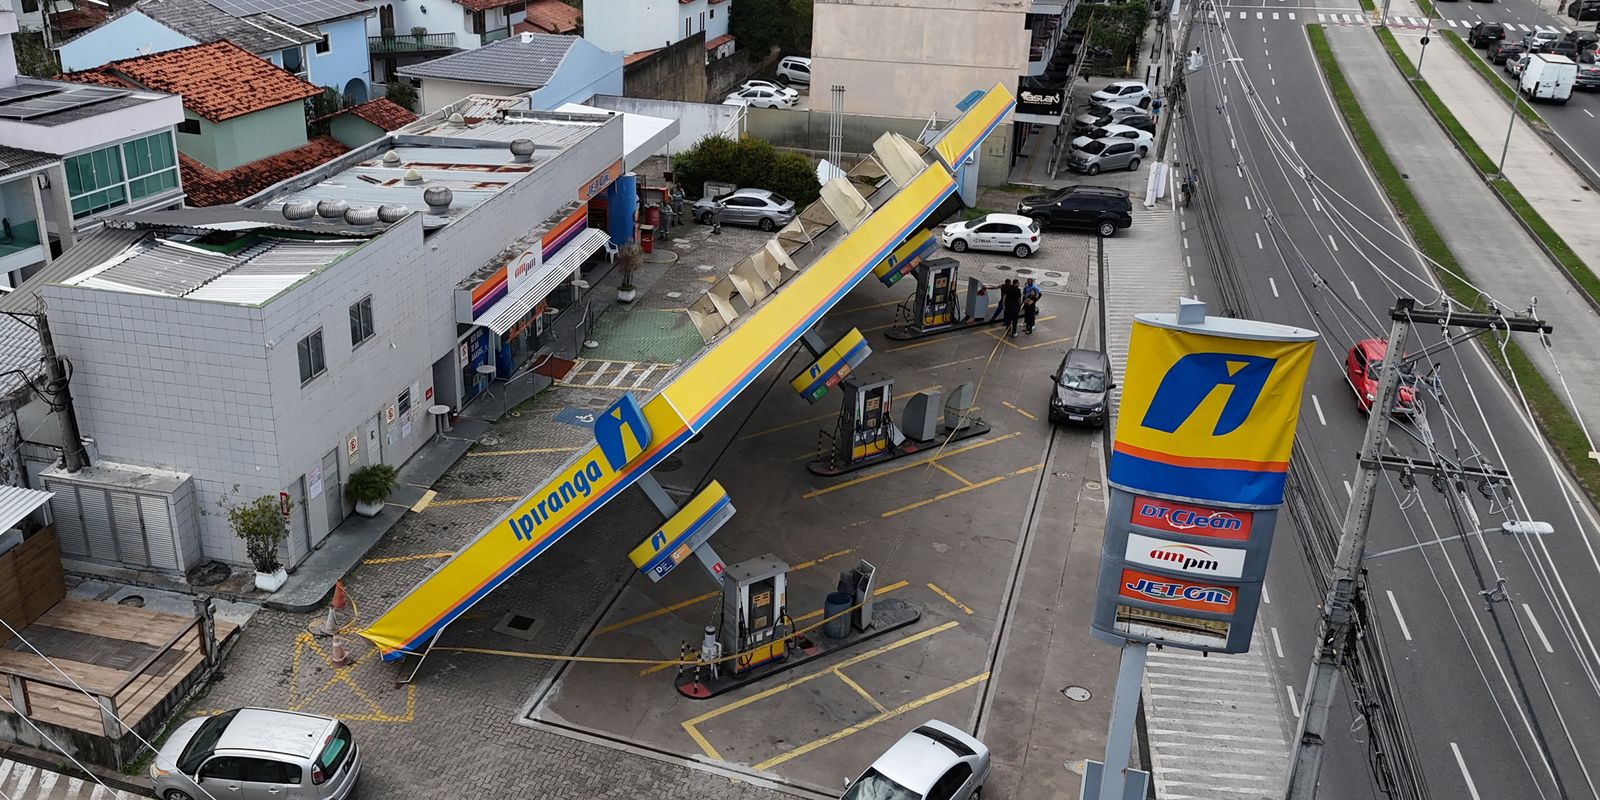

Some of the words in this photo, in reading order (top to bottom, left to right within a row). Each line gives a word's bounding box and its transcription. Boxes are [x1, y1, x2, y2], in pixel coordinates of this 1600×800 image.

[508, 460, 603, 542] Ipiranga
[1140, 504, 1171, 519] DT
[1171, 509, 1242, 531] Clean
[1149, 549, 1218, 571] ampm
[1126, 578, 1183, 597] JET
[1183, 586, 1232, 605] OIL
